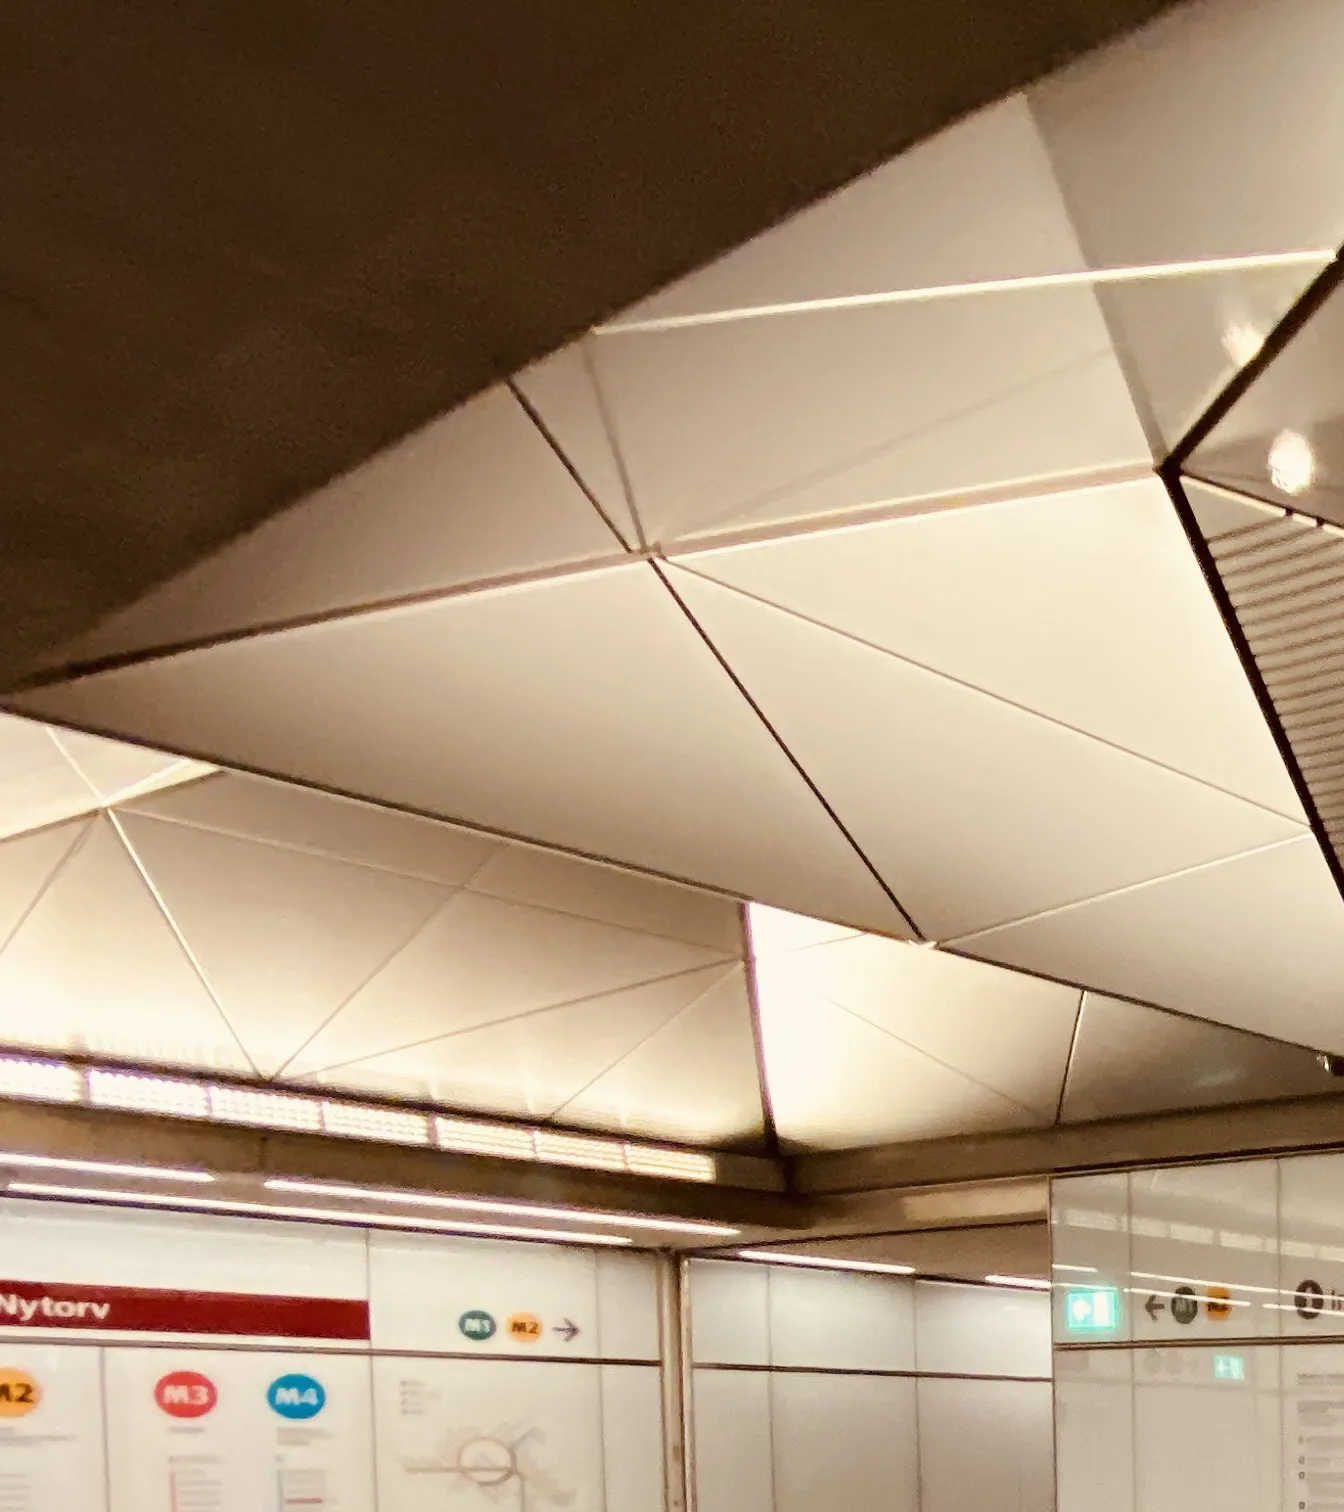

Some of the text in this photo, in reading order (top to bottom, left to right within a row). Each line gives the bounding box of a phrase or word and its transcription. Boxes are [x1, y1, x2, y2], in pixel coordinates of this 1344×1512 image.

[512, 1321, 540, 1334] M2
[164, 1385, 209, 1405] M3
[275, 1387, 319, 1405] M4
